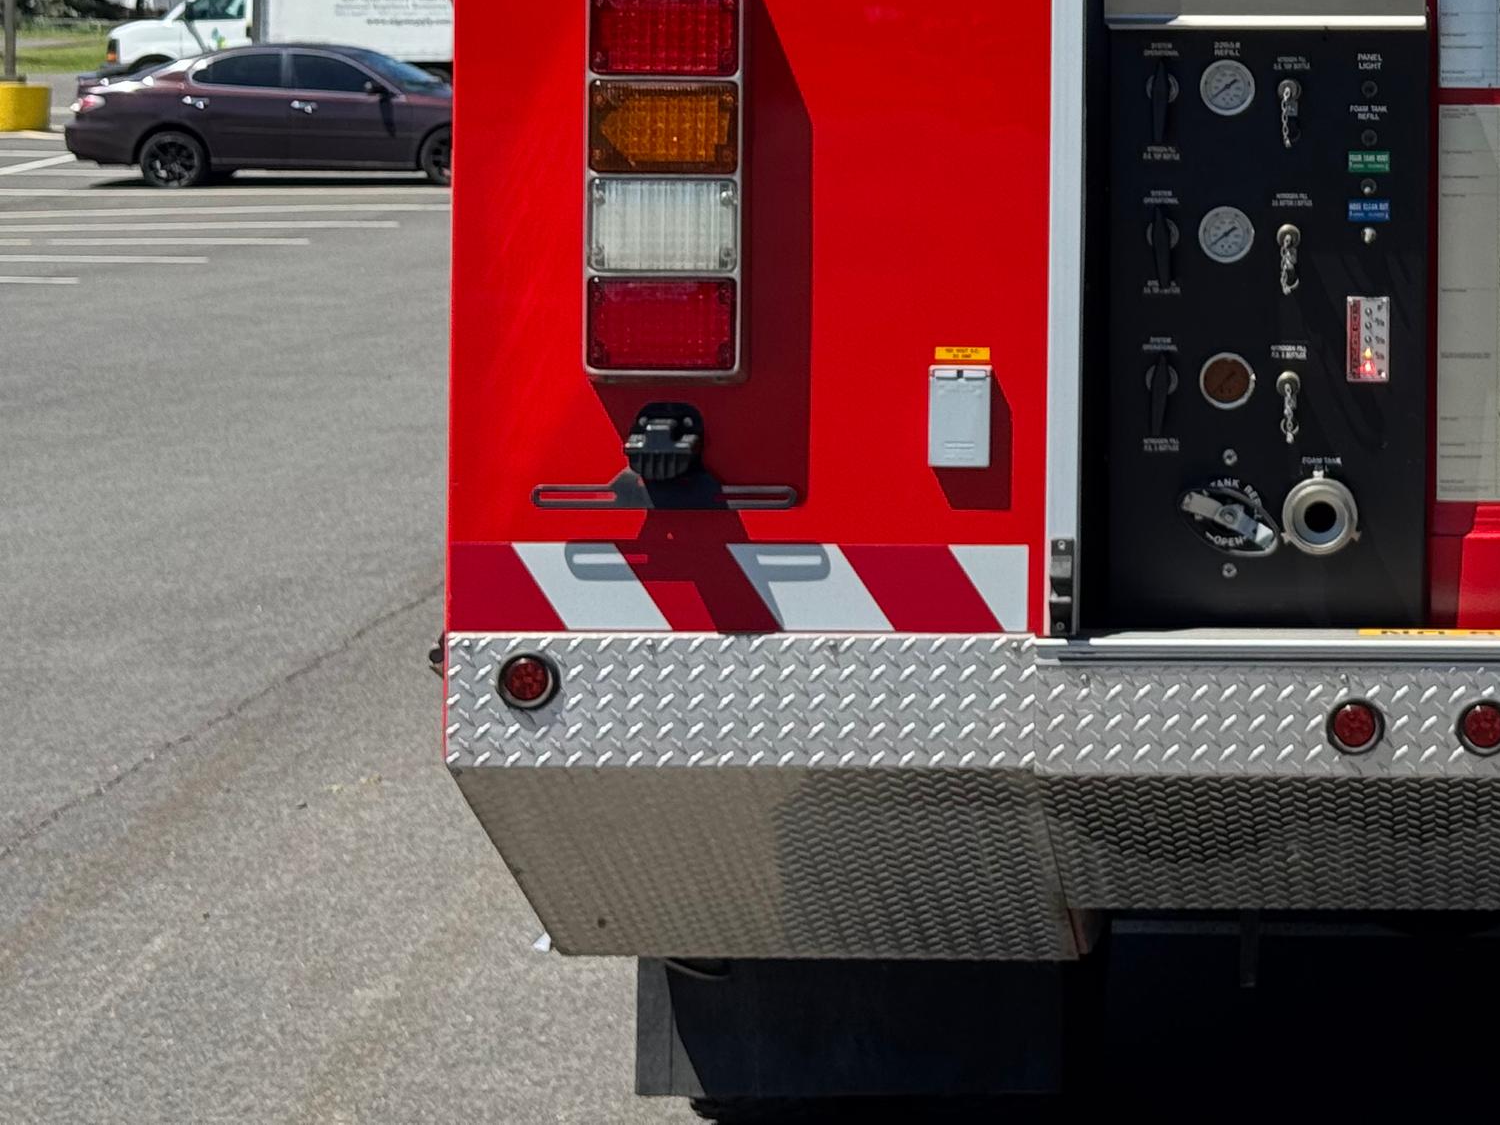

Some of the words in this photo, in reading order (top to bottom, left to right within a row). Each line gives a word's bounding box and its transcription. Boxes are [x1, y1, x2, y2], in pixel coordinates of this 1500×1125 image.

[1357, 53, 1382, 61] PANEL
[1358, 62, 1382, 70] LIGHT
[1350, 105, 1369, 113] FOAM
[1371, 105, 1388, 113] TANK
[1357, 112, 1380, 120] REFILL
[1210, 478, 1240, 488] TANK
[1214, 535, 1244, 546] OPEN
